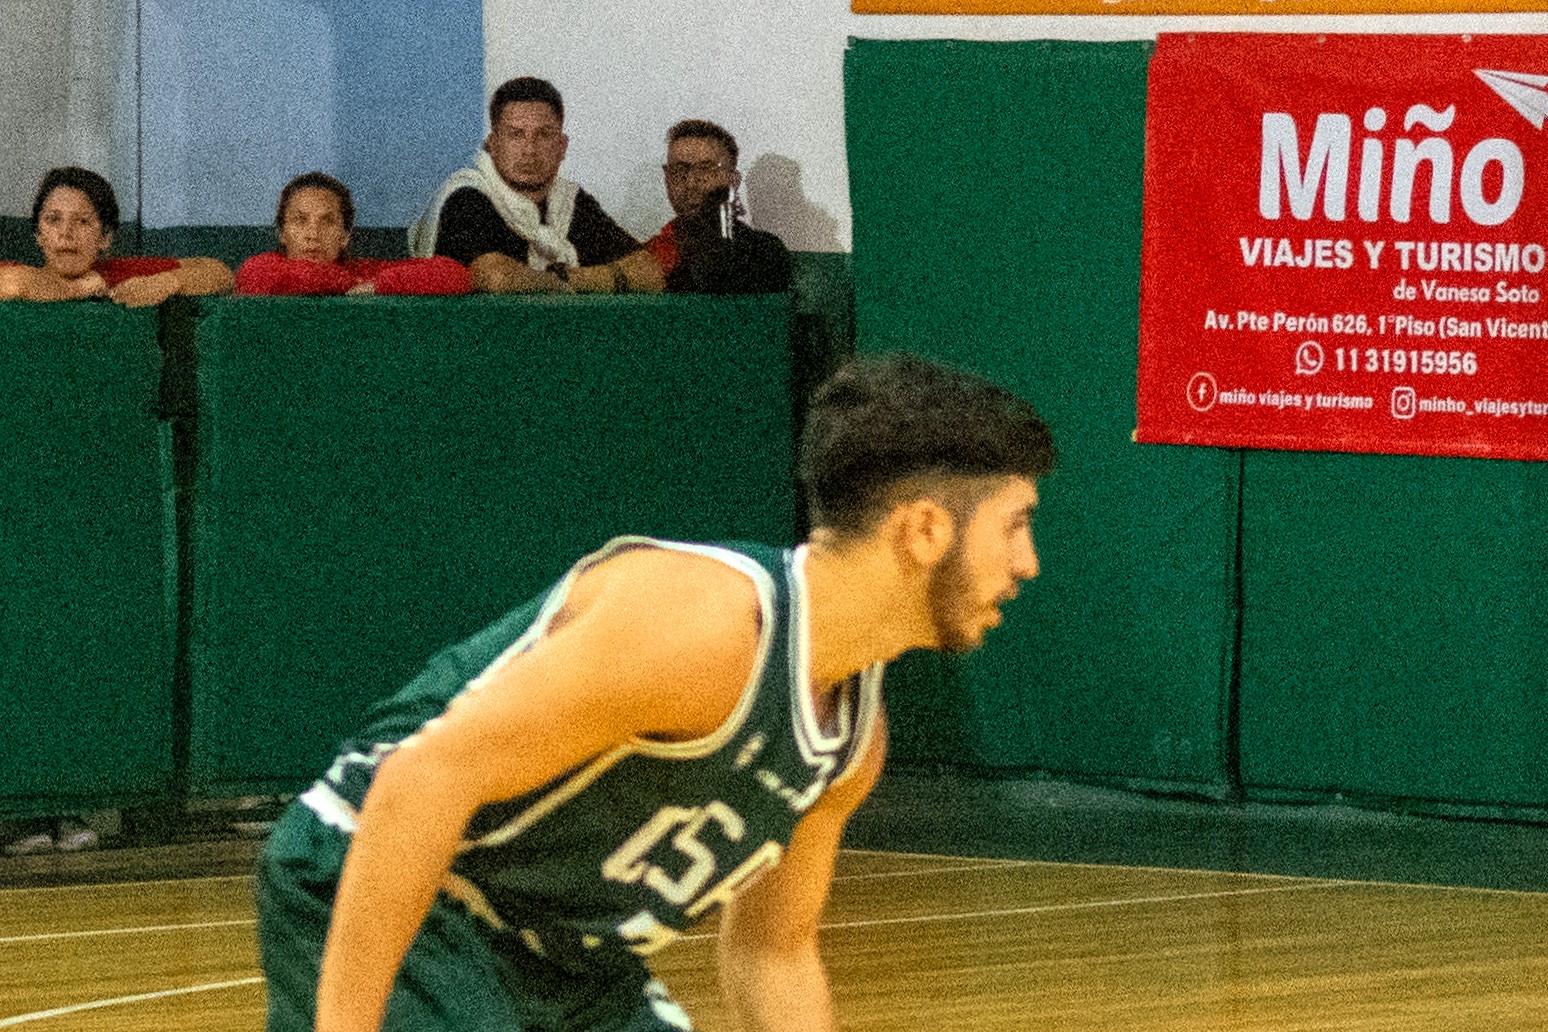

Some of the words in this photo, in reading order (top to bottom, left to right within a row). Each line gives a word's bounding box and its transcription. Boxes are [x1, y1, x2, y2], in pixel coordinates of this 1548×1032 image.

[1257, 103, 1525, 226] Miño
[1239, 237, 1354, 270] VIAJES
[1363, 240, 1385, 270] Y
[1394, 241, 1546, 273] TURISMO
[1393, 279, 1416, 301] de
[1421, 280, 1490, 302] Vanesa
[1494, 282, 1540, 303] Soto
[1204, 309, 1234, 331] Av.
[1237, 310, 1269, 331] Pte
[1272, 311, 1329, 333] Perón
[1332, 313, 1373, 336] 626,
[1438, 316, 1483, 340] (San
[1219, 387, 1257, 405] miño
[1258, 390, 1302, 410] viajes
[1304, 396, 1314, 411] y
[1316, 393, 1374, 409] turismo
